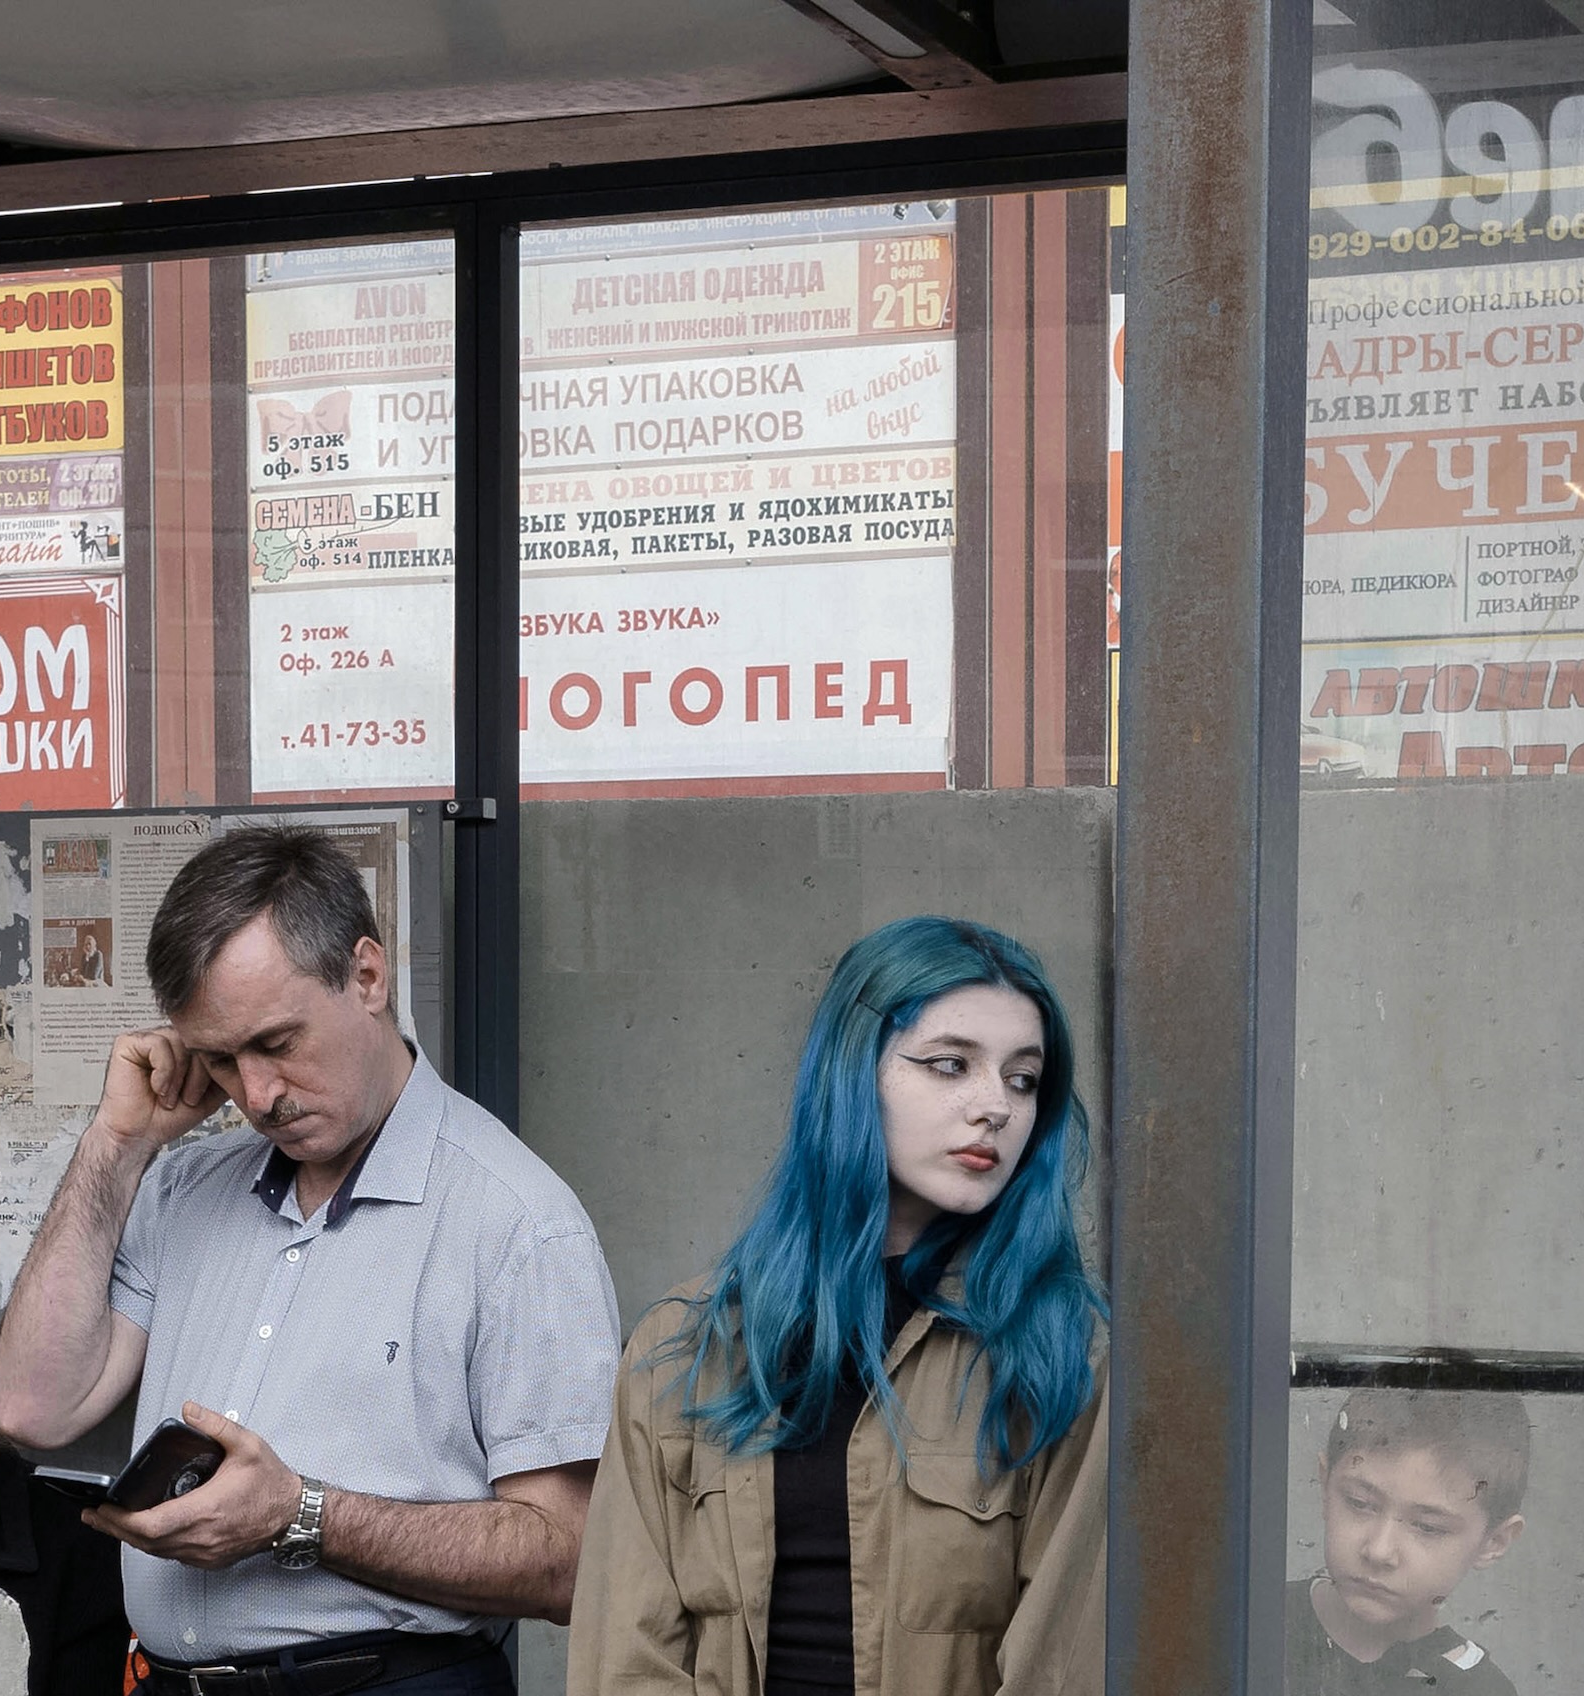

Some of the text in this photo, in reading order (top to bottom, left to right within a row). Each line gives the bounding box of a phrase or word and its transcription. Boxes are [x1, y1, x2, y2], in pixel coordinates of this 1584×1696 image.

[874, 239, 940, 263] 2 ЭТАЖ
[890, 265, 925, 280] ОФИС
[572, 261, 825, 315] ДЕТСКАЯ ОДЕЖДА
[355, 283, 426, 320] AVON
[873, 281, 941, 329] 215
[288, 326, 386, 352] БЕСПЛАТНАЯ
[547, 320, 634, 350] ЖЕНСКИЙ
[639, 322, 650, 343] И
[655, 311, 747, 342] МУЖСКОЙ
[752, 307, 851, 335] ТРИКОТАЖ
[254, 349, 397, 379] ПРЕДСТАВИТЕЛЕЙ И
[619, 362, 804, 405] УПАКОВКА
[826, 348, 941, 417] на любой
[867, 403, 922, 440] вкус
[268, 433, 344, 452] 5 этаж
[378, 411, 803, 467] И ПОДАРКОВ
[60, 463, 115, 481] 2 этаж
[263, 454, 349, 480] оф. 515
[608, 457, 951, 499] ОВОЩЕЙ И ЦВЕТОВ
[58, 485, 86, 508] оф.
[577, 489, 954, 533] УДОБРЕНИЯ И ЯДОХИМИКАТЫ
[304, 537, 358, 549] 5 этаж
[367, 518, 954, 569] ПЛЕНКА ИКОВАЯ, ПАКЕТЫ, РАЗОВАЯ ПОСУДА
[1477, 535, 1576, 559] ПОРТНОЙ,
[300, 552, 362, 570] оф. 514
[1352, 572, 1456, 596] ПЕДИКЮРА
[1477, 567, 1578, 589] ФОТОГРАФ
[1477, 594, 1578, 617] ДИЗАЙНЕР
[617, 607, 720, 632] ЗВУКА»
[280, 624, 349, 642] 2 этаж
[279, 653, 321, 676] Оф.
[330, 650, 370, 669] 226
